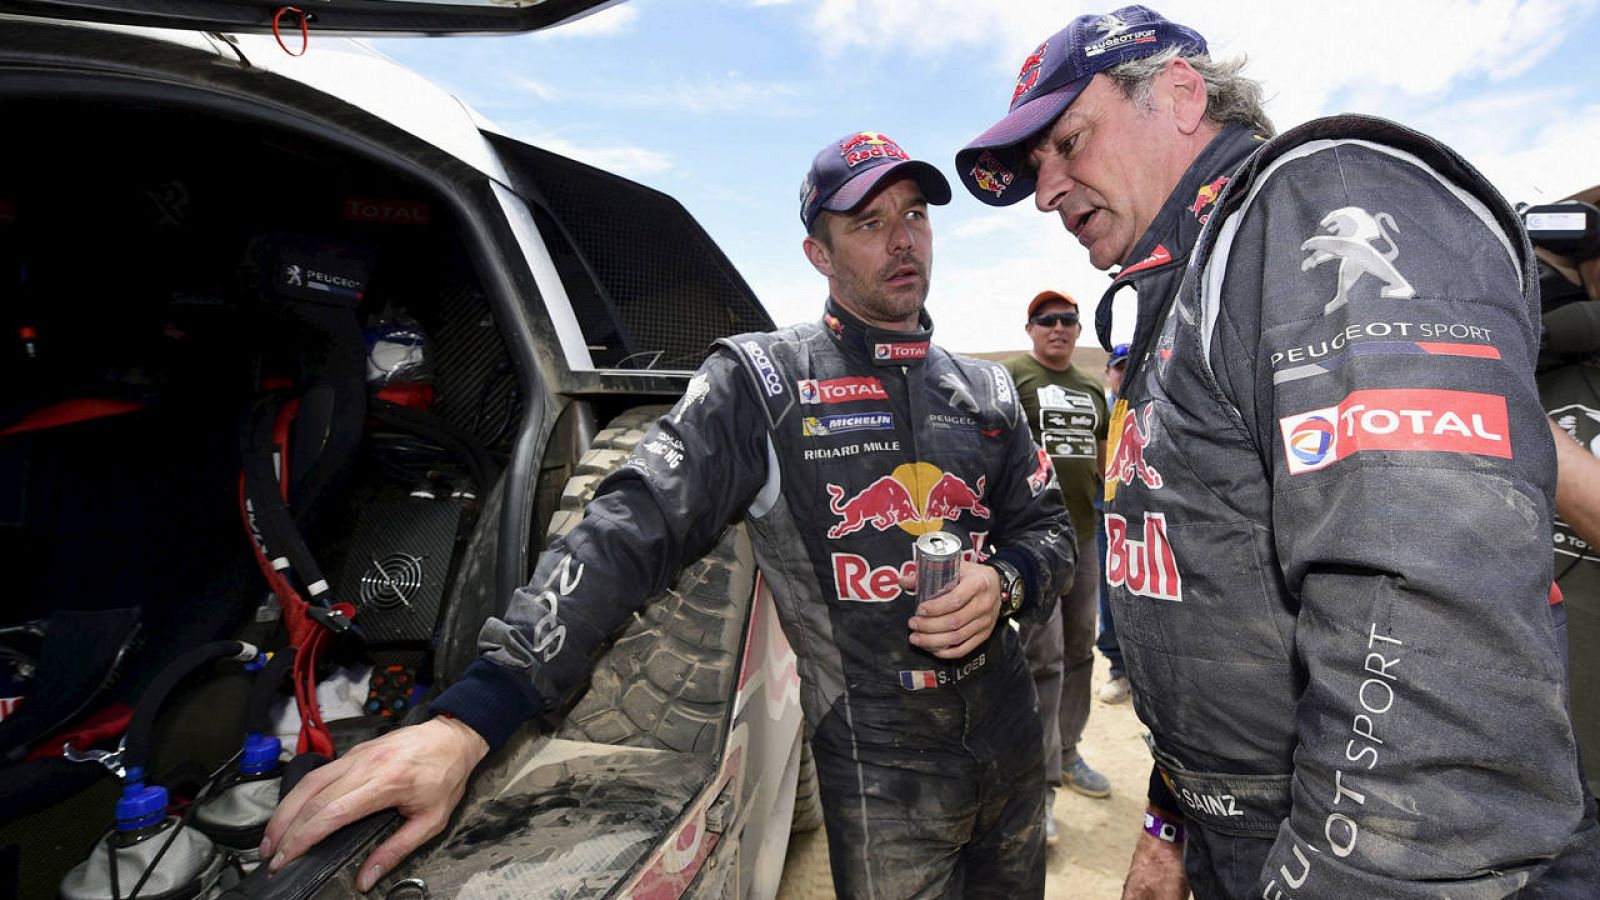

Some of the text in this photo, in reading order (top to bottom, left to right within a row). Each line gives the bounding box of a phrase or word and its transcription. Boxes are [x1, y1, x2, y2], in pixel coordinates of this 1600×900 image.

[846, 143, 885, 168] Red
[344, 200, 430, 221] TOTAL
[306, 270, 361, 288] PEUGEO
[894, 346, 928, 357] TOTAL
[1270, 321, 1492, 368] PEUGEOT SPORT
[741, 341, 783, 398] sparco
[819, 383, 886, 399] TOTAL
[829, 414, 892, 431] MICHELIN
[929, 413, 977, 427] PEUGEO
[1341, 404, 1502, 441] TOTAL
[804, 440, 900, 461] RICHARD MILLE
[1104, 511, 1183, 602] Bull
[956, 653, 986, 681] LOEB
[1345, 622, 1403, 770] SPORT
[1181, 788, 1244, 817] SAINZ
